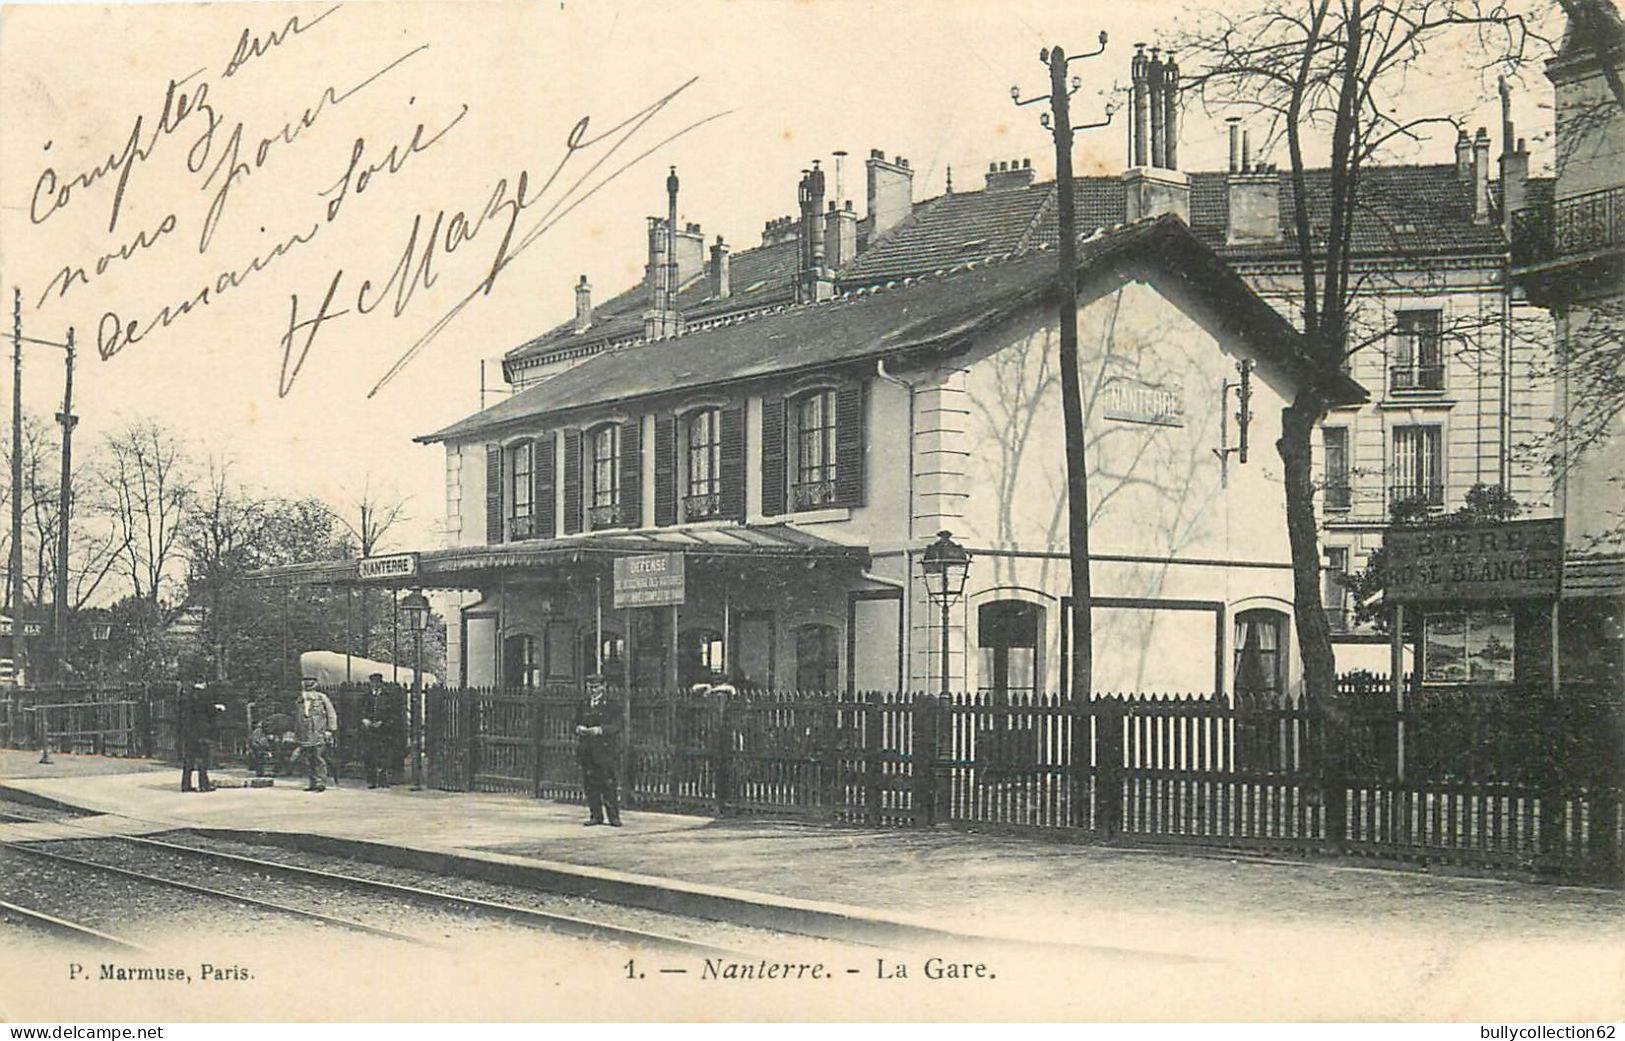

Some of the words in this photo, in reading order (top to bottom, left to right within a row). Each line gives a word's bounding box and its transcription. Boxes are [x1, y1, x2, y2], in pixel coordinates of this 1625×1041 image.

[1110, 386, 1179, 417] NANTERRE
[362, 558, 409, 576] NANTERRE
[69, 963, 90, 980] P.
[100, 963, 192, 984] Marmuse,
[201, 963, 255, 981] Paris.
[624, 959, 645, 979] 1.
[702, 958, 832, 980] Nanterre.
[877, 958, 908, 979] La
[924, 958, 997, 980] Gare.
